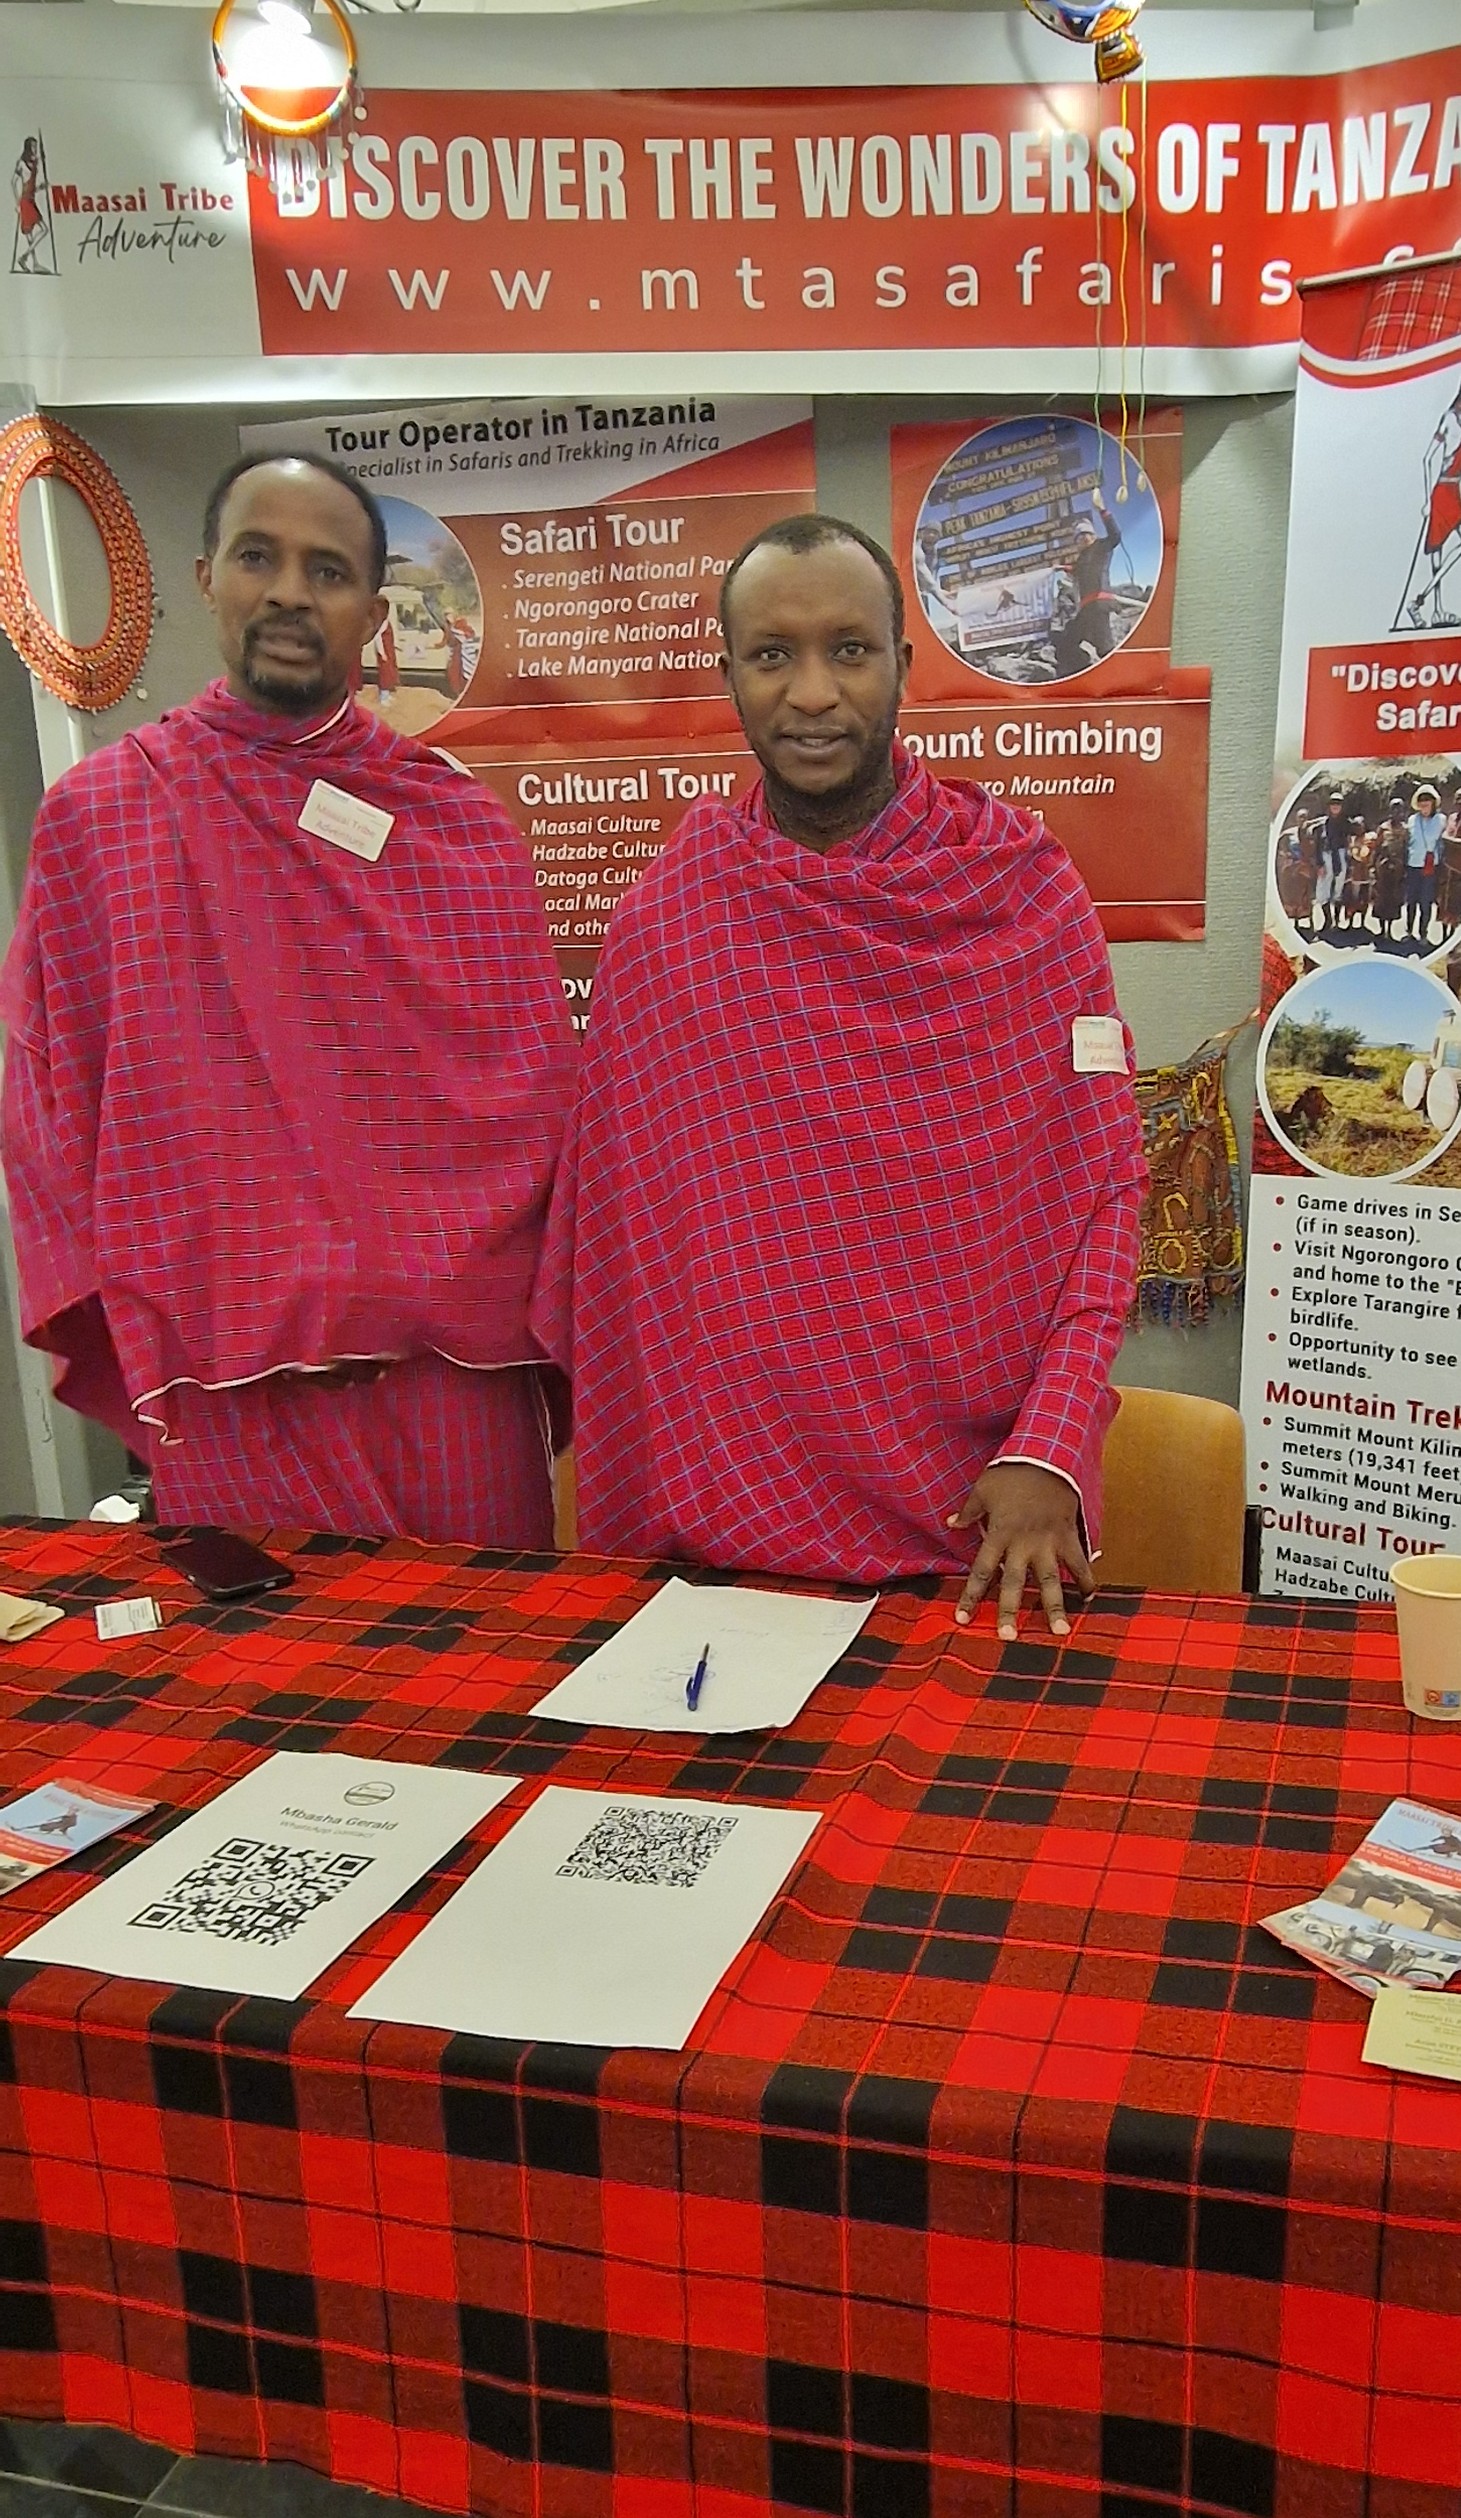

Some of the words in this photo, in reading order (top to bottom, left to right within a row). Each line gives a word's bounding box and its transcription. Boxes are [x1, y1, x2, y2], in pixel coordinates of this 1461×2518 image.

[274, 135, 628, 221] DISCOVER
[645, 137, 777, 220] THE
[795, 122, 1137, 218] WONDERS
[1156, 122, 1242, 214] OF
[51, 184, 148, 214] Maasai
[160, 182, 233, 212] Tribe
[77, 214, 227, 264] Adventure
[286, 245, 1461, 312] www.mtasafaris
[325, 426, 390, 453] Tour
[399, 416, 533, 453] Operator
[541, 408, 568, 437] in
[575, 396, 716, 432] Tanzania
[345, 456, 421, 478] pecialist
[426, 456, 443, 473] in
[449, 451, 512, 472] Safaris
[518, 445, 551, 468] and
[556, 439, 634, 462] Trekking
[639, 437, 657, 456] in
[662, 433, 720, 454] Africa
[500, 516, 598, 556] Safari
[605, 513, 685, 548] Tour
[512, 565, 605, 592] Serengeti
[609, 556, 696, 583] National
[514, 597, 633, 623] Ngorongoro
[637, 591, 700, 612] Crater
[515, 627, 610, 651] Tarangire
[614, 619, 700, 643] National
[517, 656, 563, 679] Lake
[567, 654, 653, 679] Manyara
[1331, 662, 1461, 693] "Discov
[894, 725, 985, 760] ount
[994, 719, 1163, 763] Climbing
[517, 768, 649, 806] Cultural
[657, 767, 737, 799] Tour
[1009, 773, 1116, 796] Mountain
[531, 818, 593, 837] Maasai
[596, 815, 662, 835] Culture
[532, 842, 608, 862] Hadzabe
[534, 869, 599, 890] Datoga
[544, 893, 581, 912] ocal
[548, 918, 570, 936] nd
[1297, 1194, 1349, 1214] Game
[1353, 1198, 1409, 1219] drives
[1415, 1202, 1432, 1220] in
[1296, 1216, 1316, 1236] (if
[1322, 1217, 1338, 1235] in
[1344, 1224, 1421, 1247] season).
[1294, 1240, 1336, 1259] Visit
[1342, 1244, 1449, 1271] Ngorongoro
[1293, 1264, 1326, 1281] and
[1331, 1266, 1380, 1287] home
[1386, 1273, 1405, 1290] to
[1410, 1275, 1440, 1294] the
[1291, 1286, 1358, 1307] Explore
[1364, 1293, 1451, 1320] Tarangire
[1290, 1308, 1359, 1331] birdlife.
[1289, 1331, 1395, 1363] Opportunity
[1400, 1346, 1419, 1363] to
[1424, 1351, 1458, 1368] see
[1287, 1356, 1373, 1380] wetlands.
[1265, 1380, 1396, 1421] Mountain
[1284, 1416, 1351, 1441] Summit
[1357, 1427, 1414, 1451] Mount
[1282, 1440, 1342, 1462] meters
[1348, 1447, 1416, 1475] (19,341
[1423, 1461, 1461, 1482] feet
[1281, 1461, 1348, 1486] Summit
[1353, 1473, 1411, 1497] Mount
[1417, 1484, 1461, 1505] Meru
[1279, 1482, 1349, 1512] Walking
[1354, 1498, 1387, 1516] and
[1392, 1503, 1458, 1530] Biking.
[1260, 1507, 1367, 1547] Cultural
[1376, 1526, 1447, 1558] Tour
[1276, 1546, 1338, 1572] Maasai
[1343, 1560, 1394, 1583] Cultu
[1274, 1567, 1349, 1596] Hadzabe
[280, 1806, 343, 1826] Mbasha
[345, 1817, 400, 1832] Gerald
